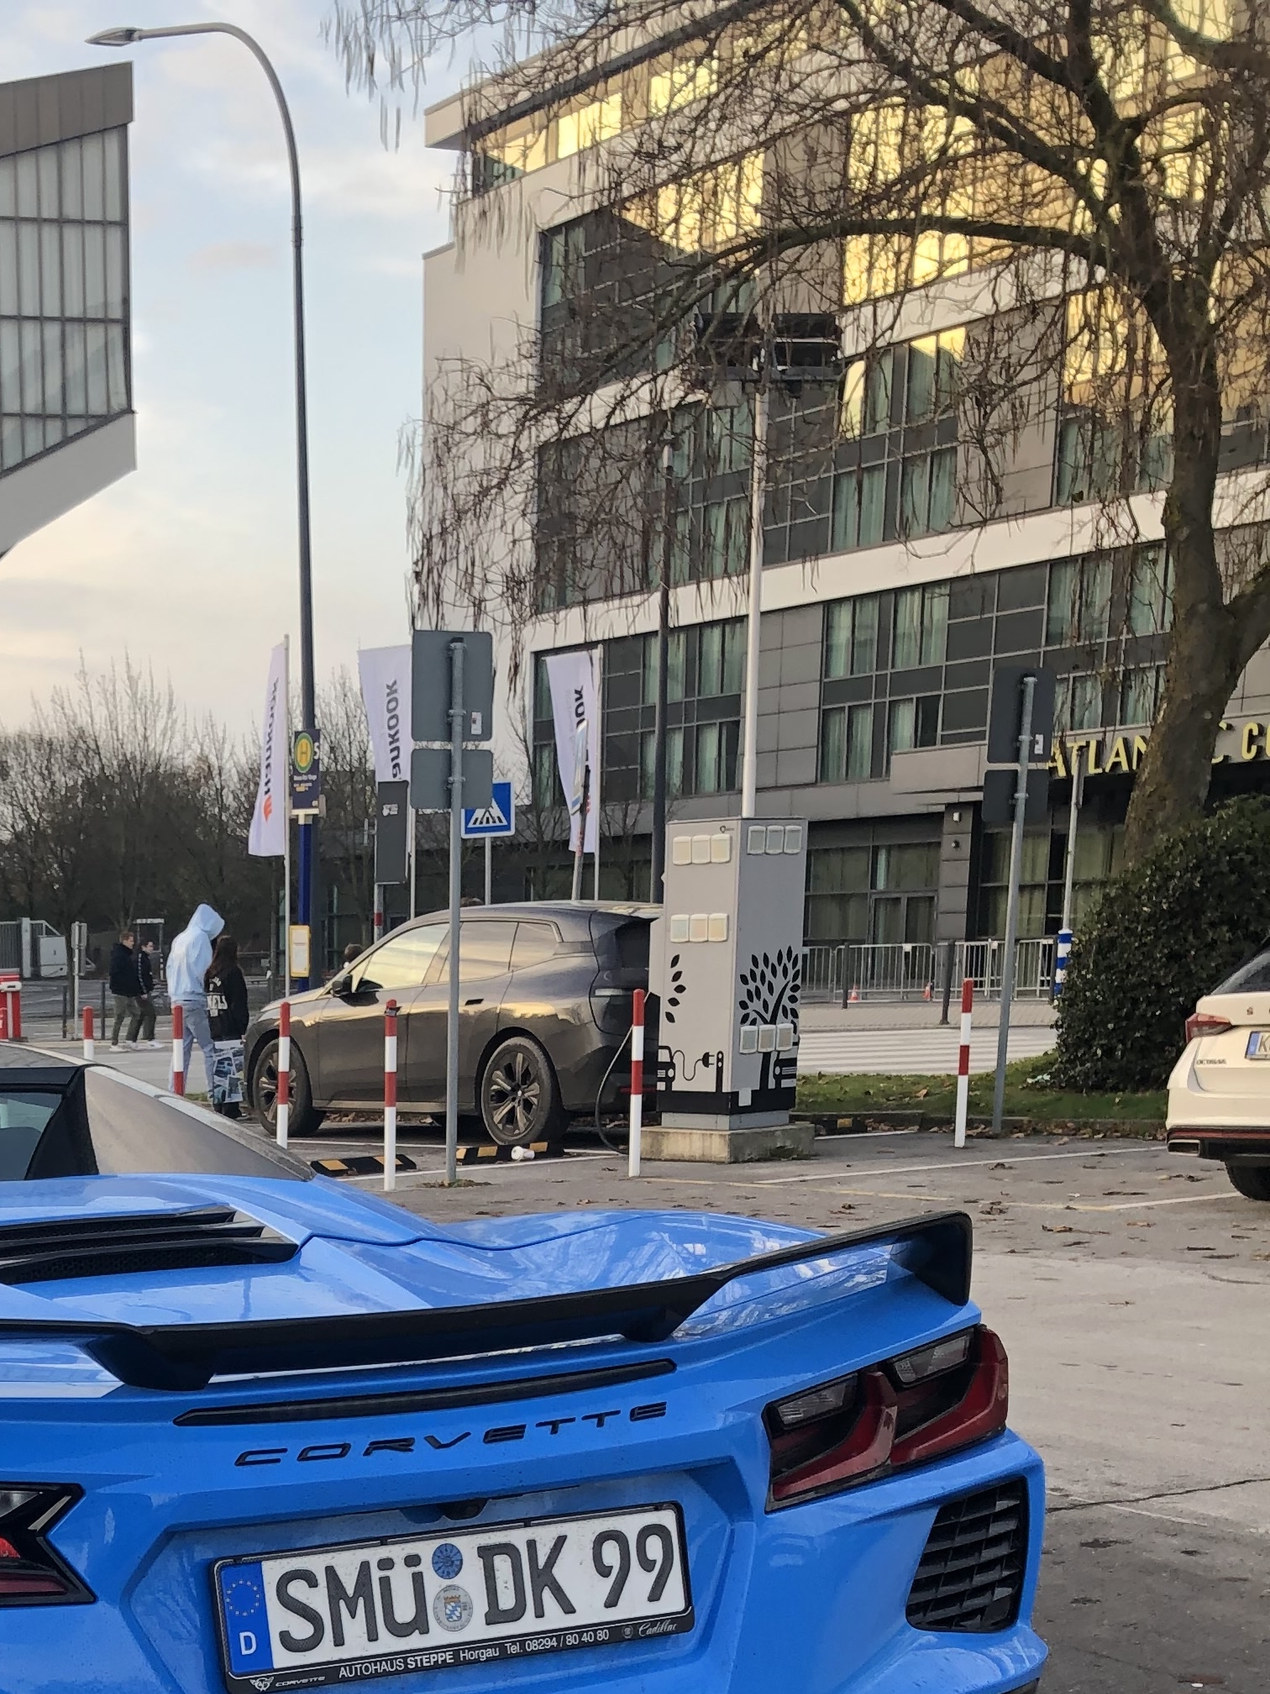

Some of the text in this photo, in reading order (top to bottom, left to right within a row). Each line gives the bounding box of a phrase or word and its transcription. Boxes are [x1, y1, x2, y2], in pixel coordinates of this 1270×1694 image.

[1241, 722, 1270, 760] C
[234, 1401, 668, 1467] CORVETTE
[276, 1554, 430, 1653] SMÜ
[477, 1534, 577, 1626] DK
[592, 1523, 674, 1609] 99
[239, 1631, 257, 1655] D
[638, 1619, 678, 1637] Cadillac
[338, 1628, 610, 1679] AUTOHAUS STEPPE Horgau Tel. 08294 / 80 40 80
